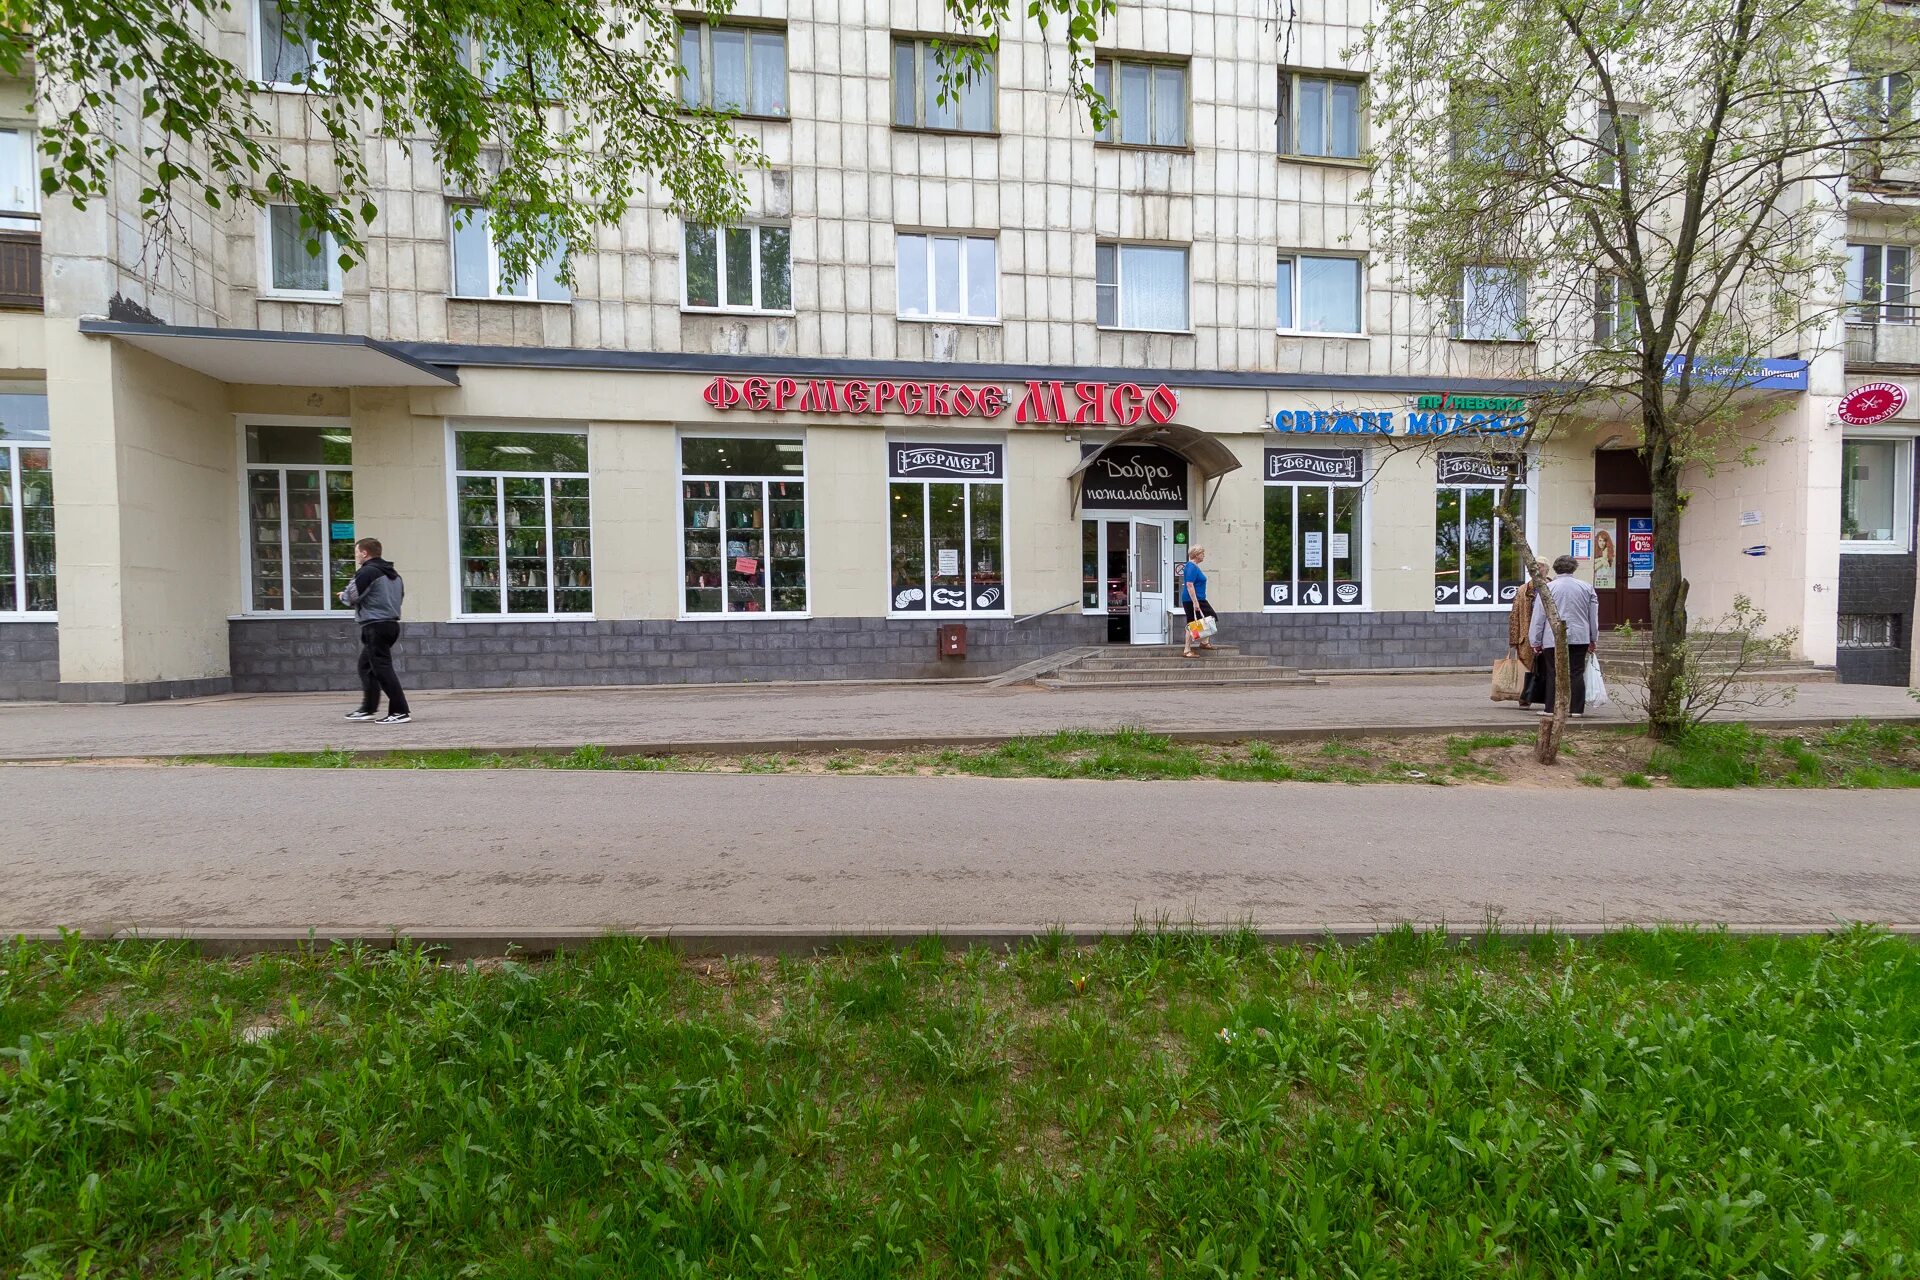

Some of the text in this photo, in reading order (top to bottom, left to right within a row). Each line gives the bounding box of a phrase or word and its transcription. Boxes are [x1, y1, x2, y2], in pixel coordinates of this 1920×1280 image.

[1761, 367, 1800, 380] Помощи
[703, 376, 1180, 425] ФЕРМЕРСКОЕ МЯСО
[1838, 383, 1902, 415] ПАРИКМАХЕРСКАЯ
[1273, 409, 1527, 437] СВЕЖЕЕ МОЛОКО
[911, 452, 982, 471] ФЕРМЕР
[1096, 455, 1173, 487] Добро
[1283, 458, 1344, 474] ФЕРМЕР
[1451, 461, 1509, 476] ФЕРМЕР
[1087, 484, 1183, 502] пожаловать!
